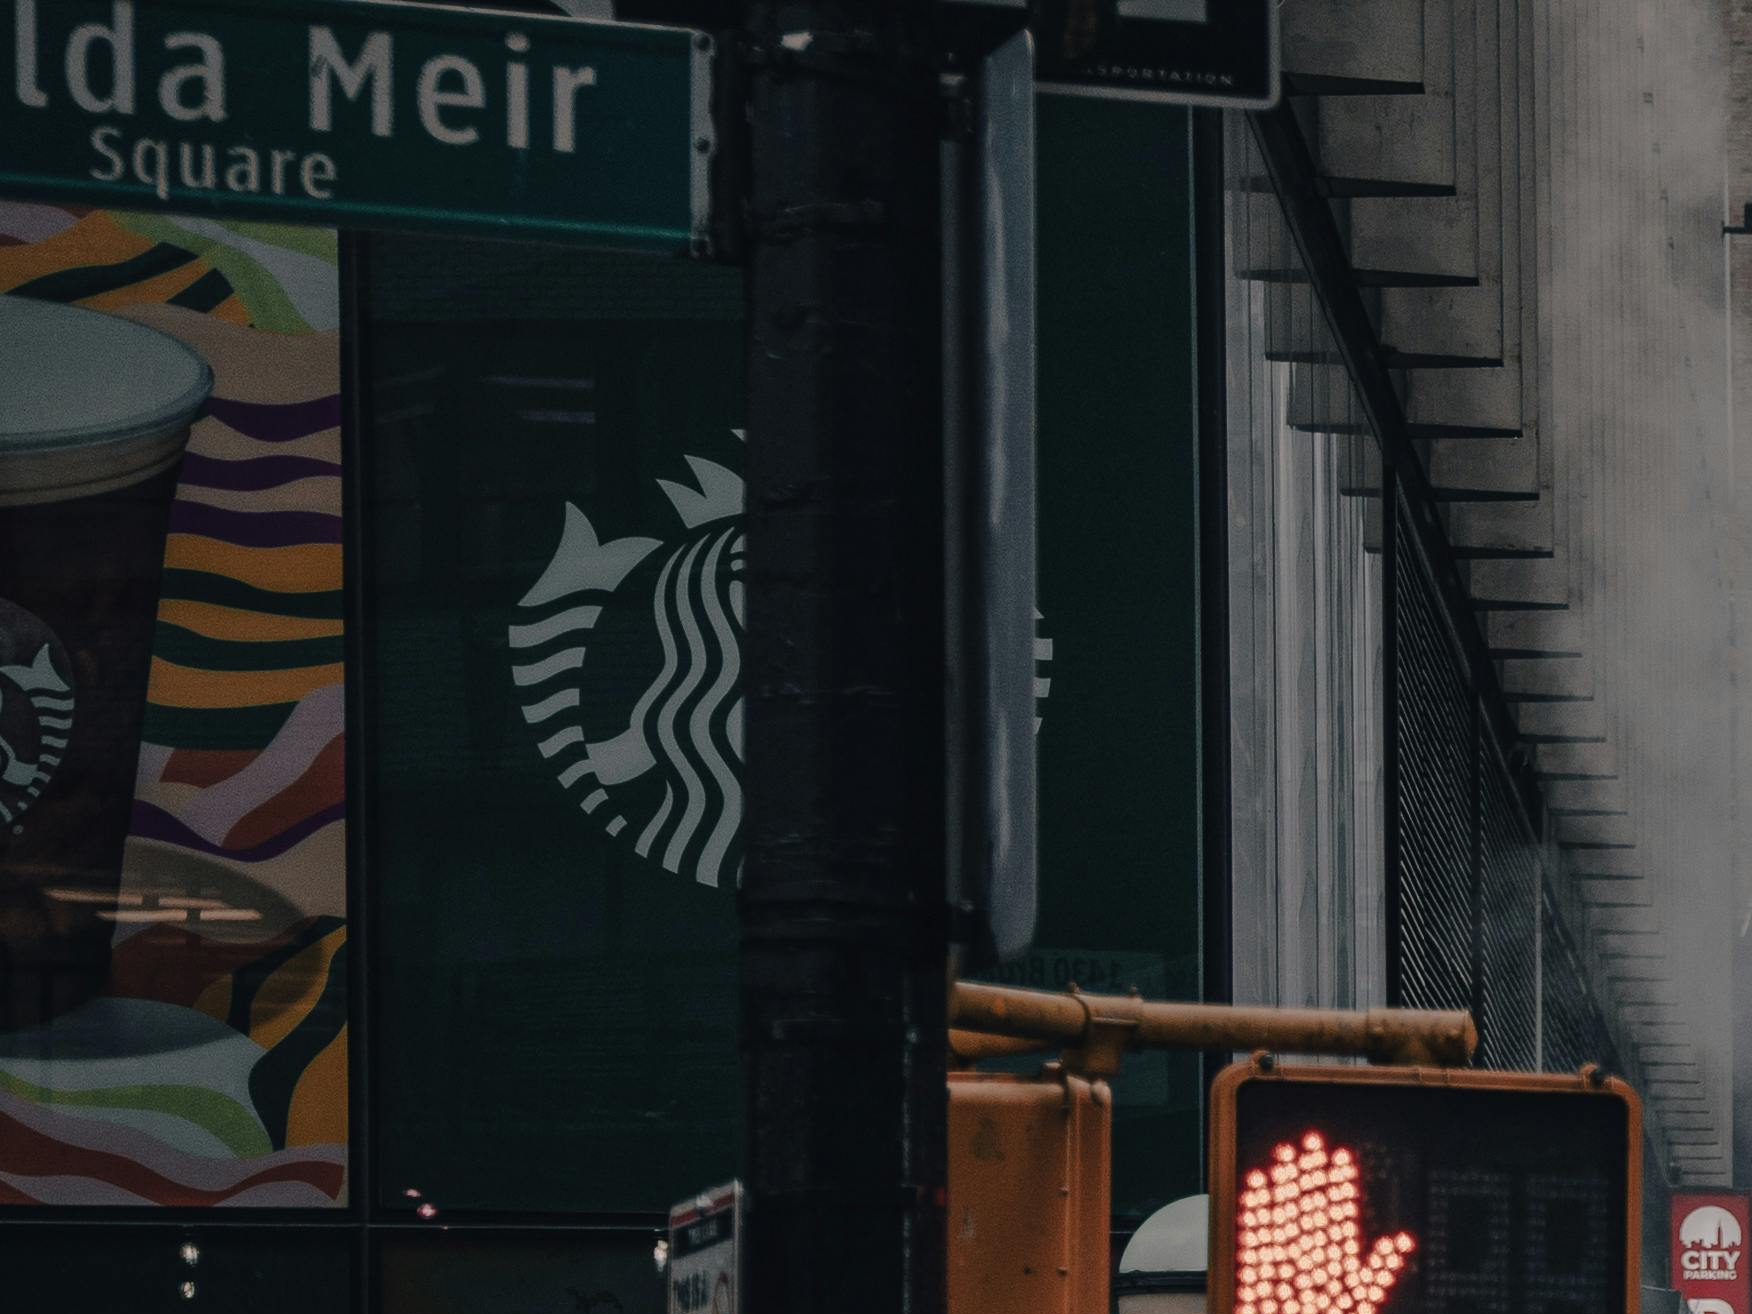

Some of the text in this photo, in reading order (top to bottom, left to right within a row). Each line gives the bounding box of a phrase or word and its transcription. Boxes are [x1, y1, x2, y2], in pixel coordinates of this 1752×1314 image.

[13, 0, 598, 153] lda Meir
[1085, 65, 1234, 86] SPORTATION
[88, 125, 339, 200] Square
[1681, 1250, 1742, 1271] CITY
[1683, 1270, 1738, 1281] PARKING
